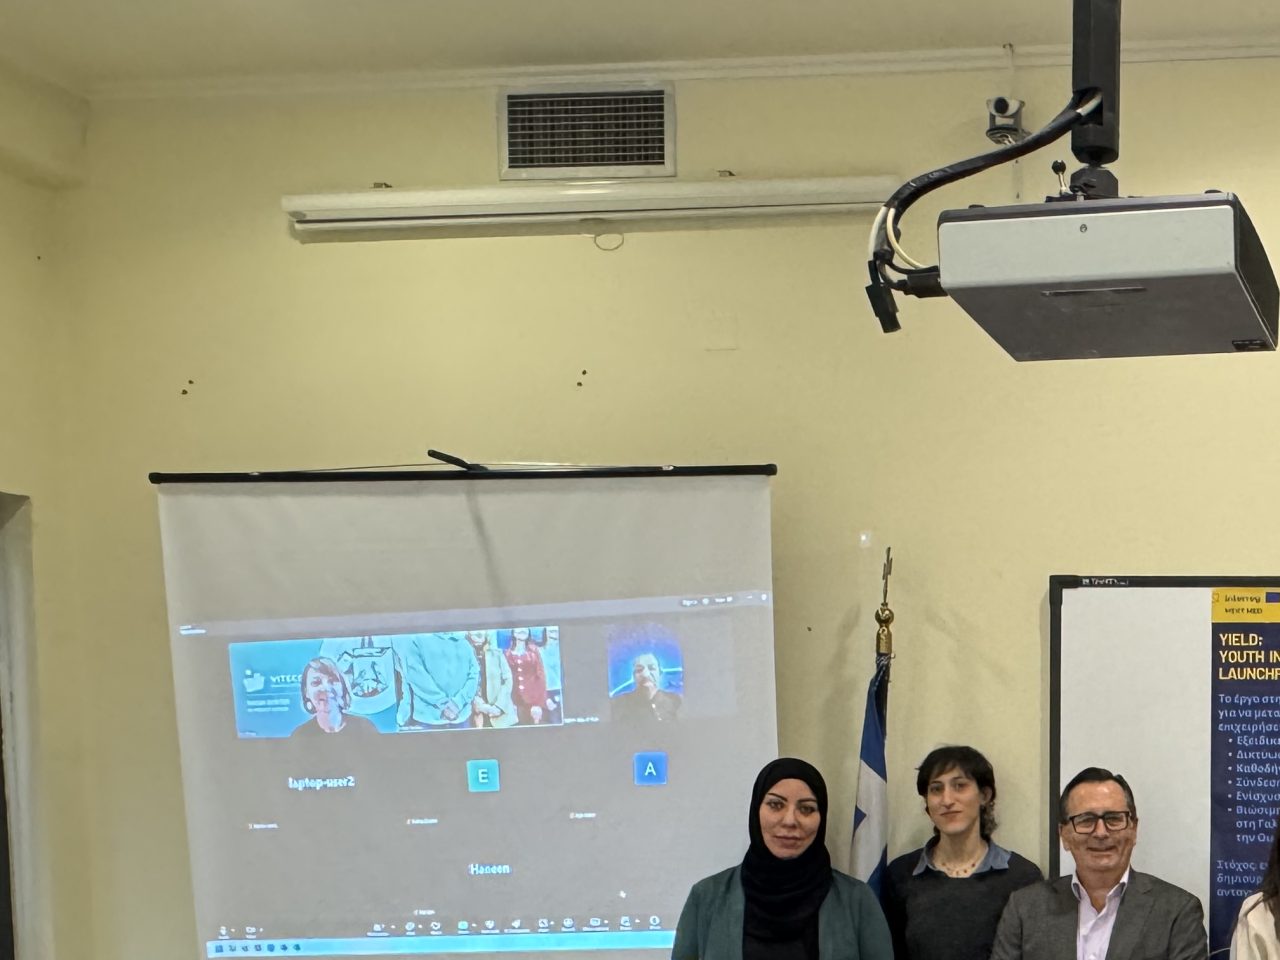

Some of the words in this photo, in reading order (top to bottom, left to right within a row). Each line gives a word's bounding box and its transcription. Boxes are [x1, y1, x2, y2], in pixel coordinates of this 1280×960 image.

[1219, 633, 1263, 646] YIELD:
[1219, 650, 1265, 664] YOUTH
[1219, 694, 1232, 703] Το
[1234, 694, 1260, 705] έργο
[1218, 709, 1236, 719] για
[1238, 709, 1252, 717] να
[644, 761, 657, 776] A
[478, 768, 488, 783] E
[1236, 821, 1256, 830] στη
[1236, 834, 1255, 843] την
